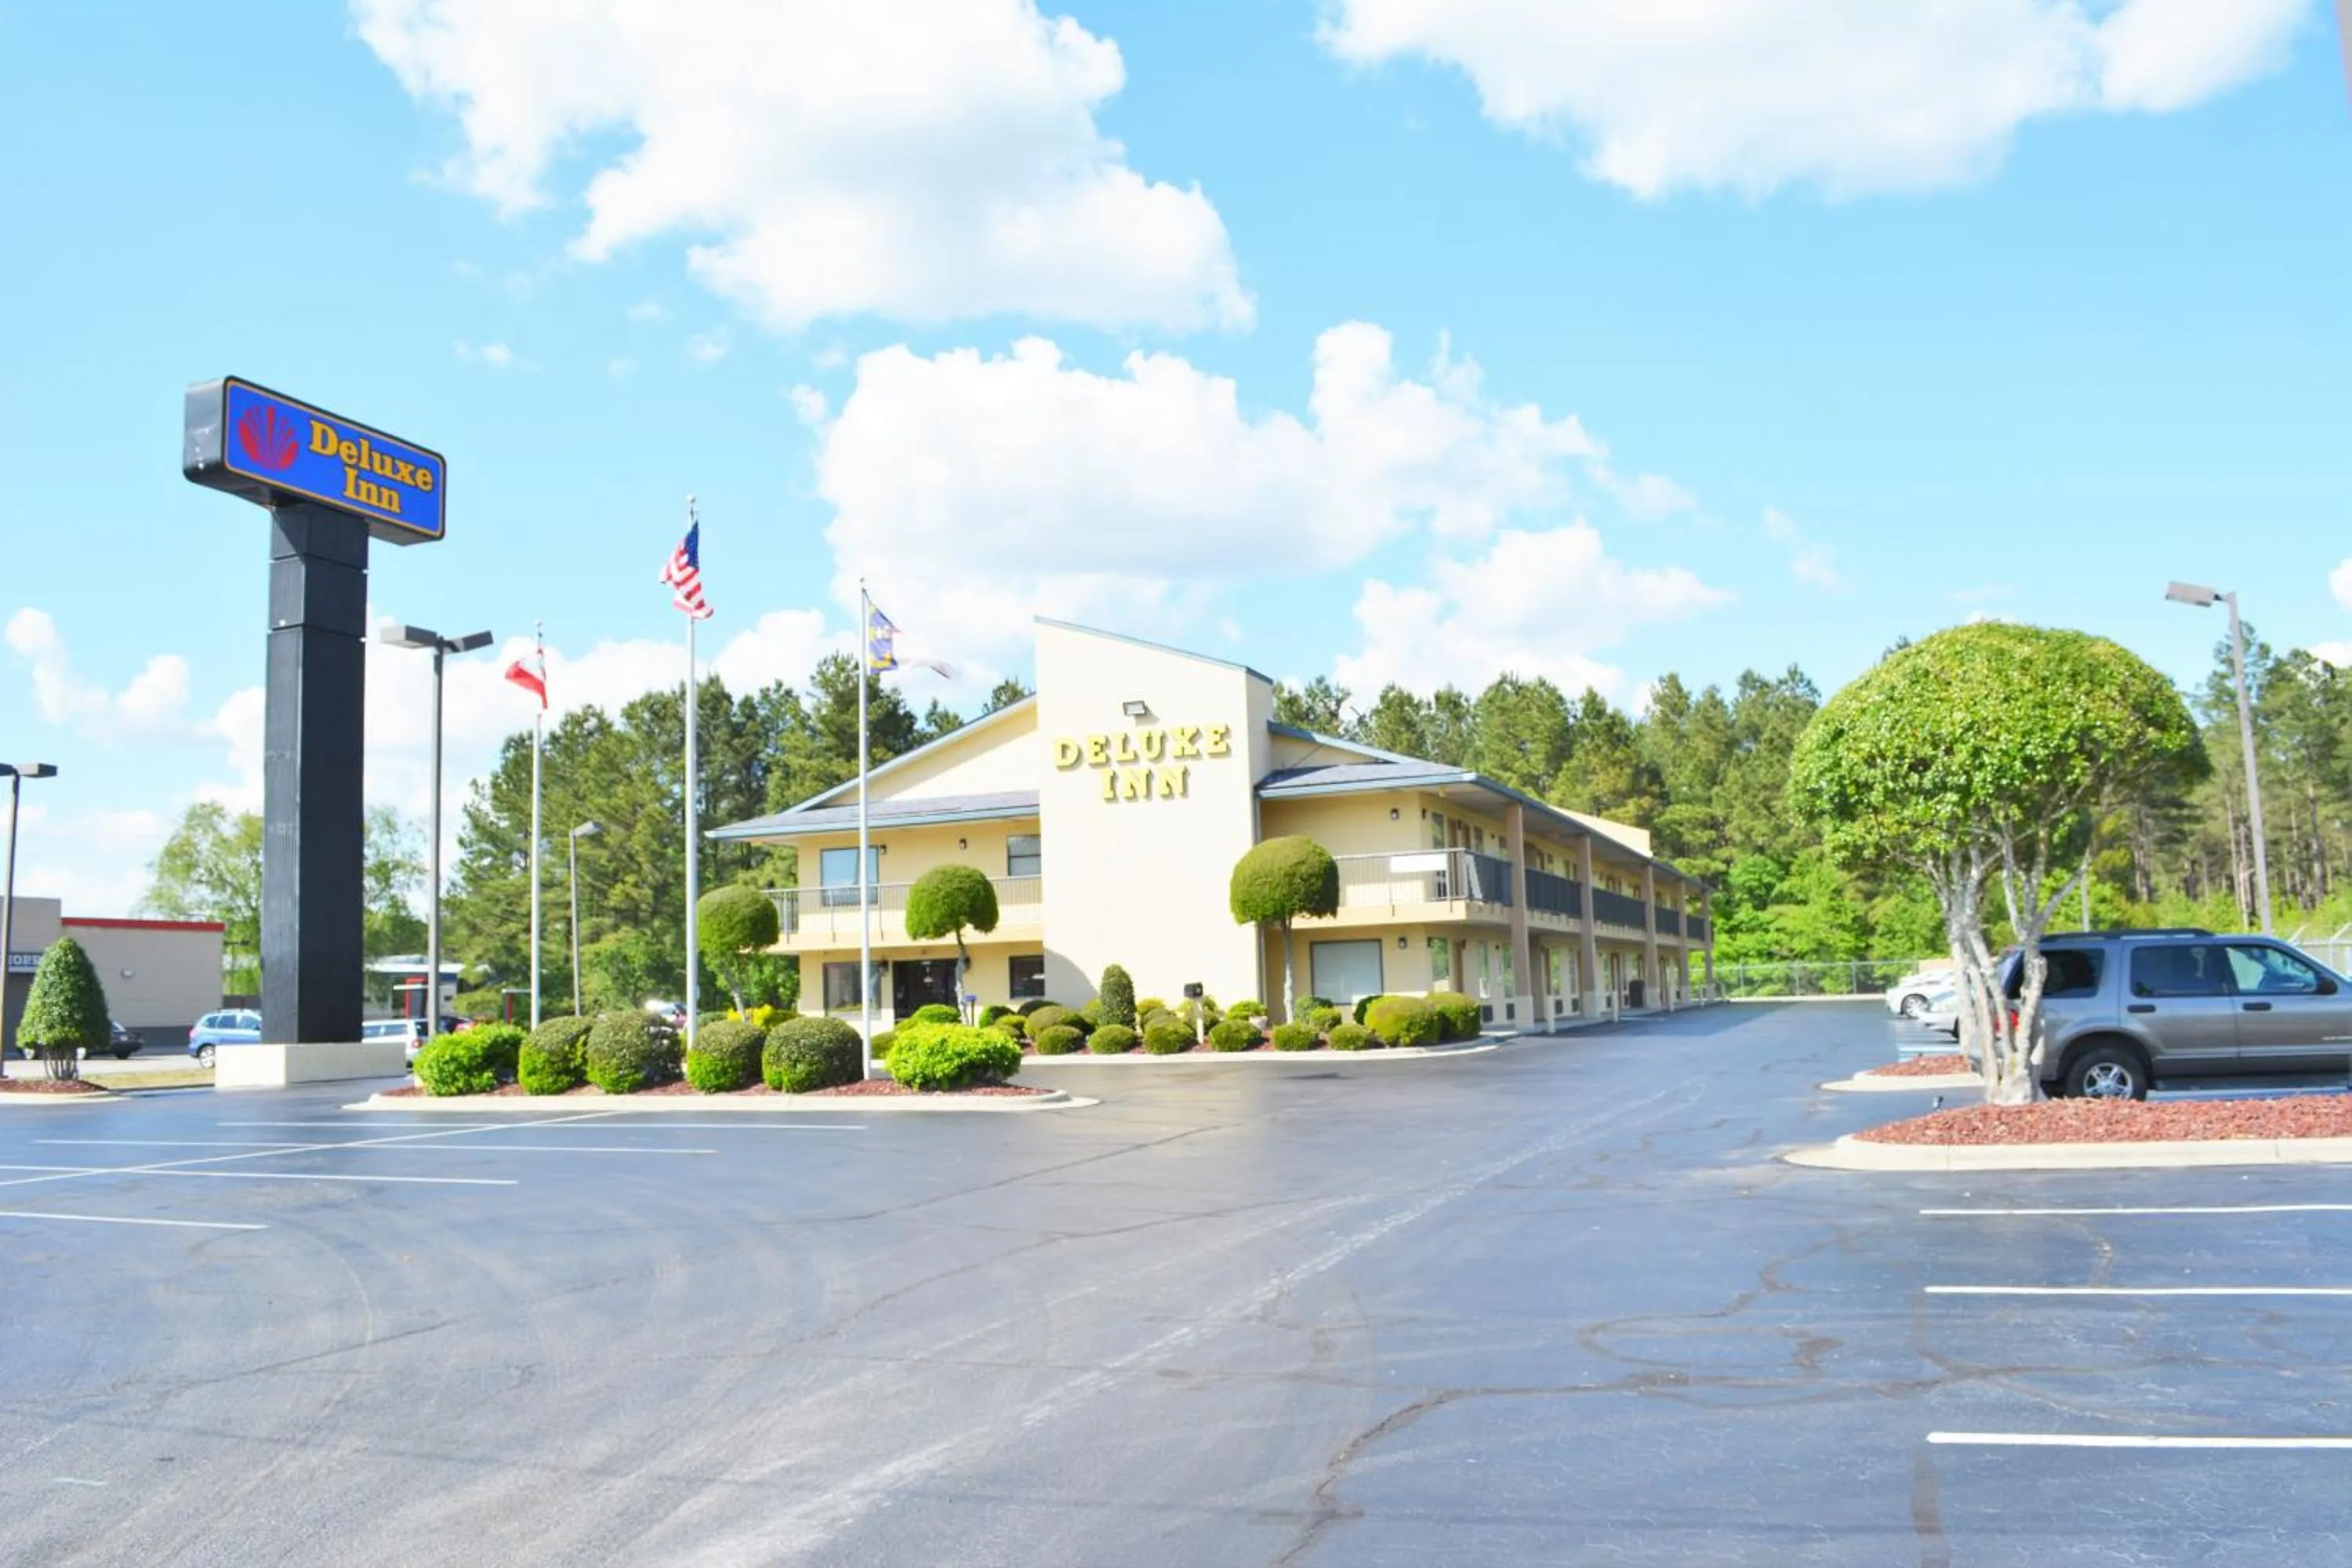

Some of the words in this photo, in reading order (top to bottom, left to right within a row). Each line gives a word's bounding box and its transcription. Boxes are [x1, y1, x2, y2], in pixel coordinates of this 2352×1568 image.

[308, 419, 434, 492] Deluxe
[342, 466, 402, 514] Inn
[1054, 723, 1232, 768] DELUXE
[1102, 765, 1189, 800] INN
